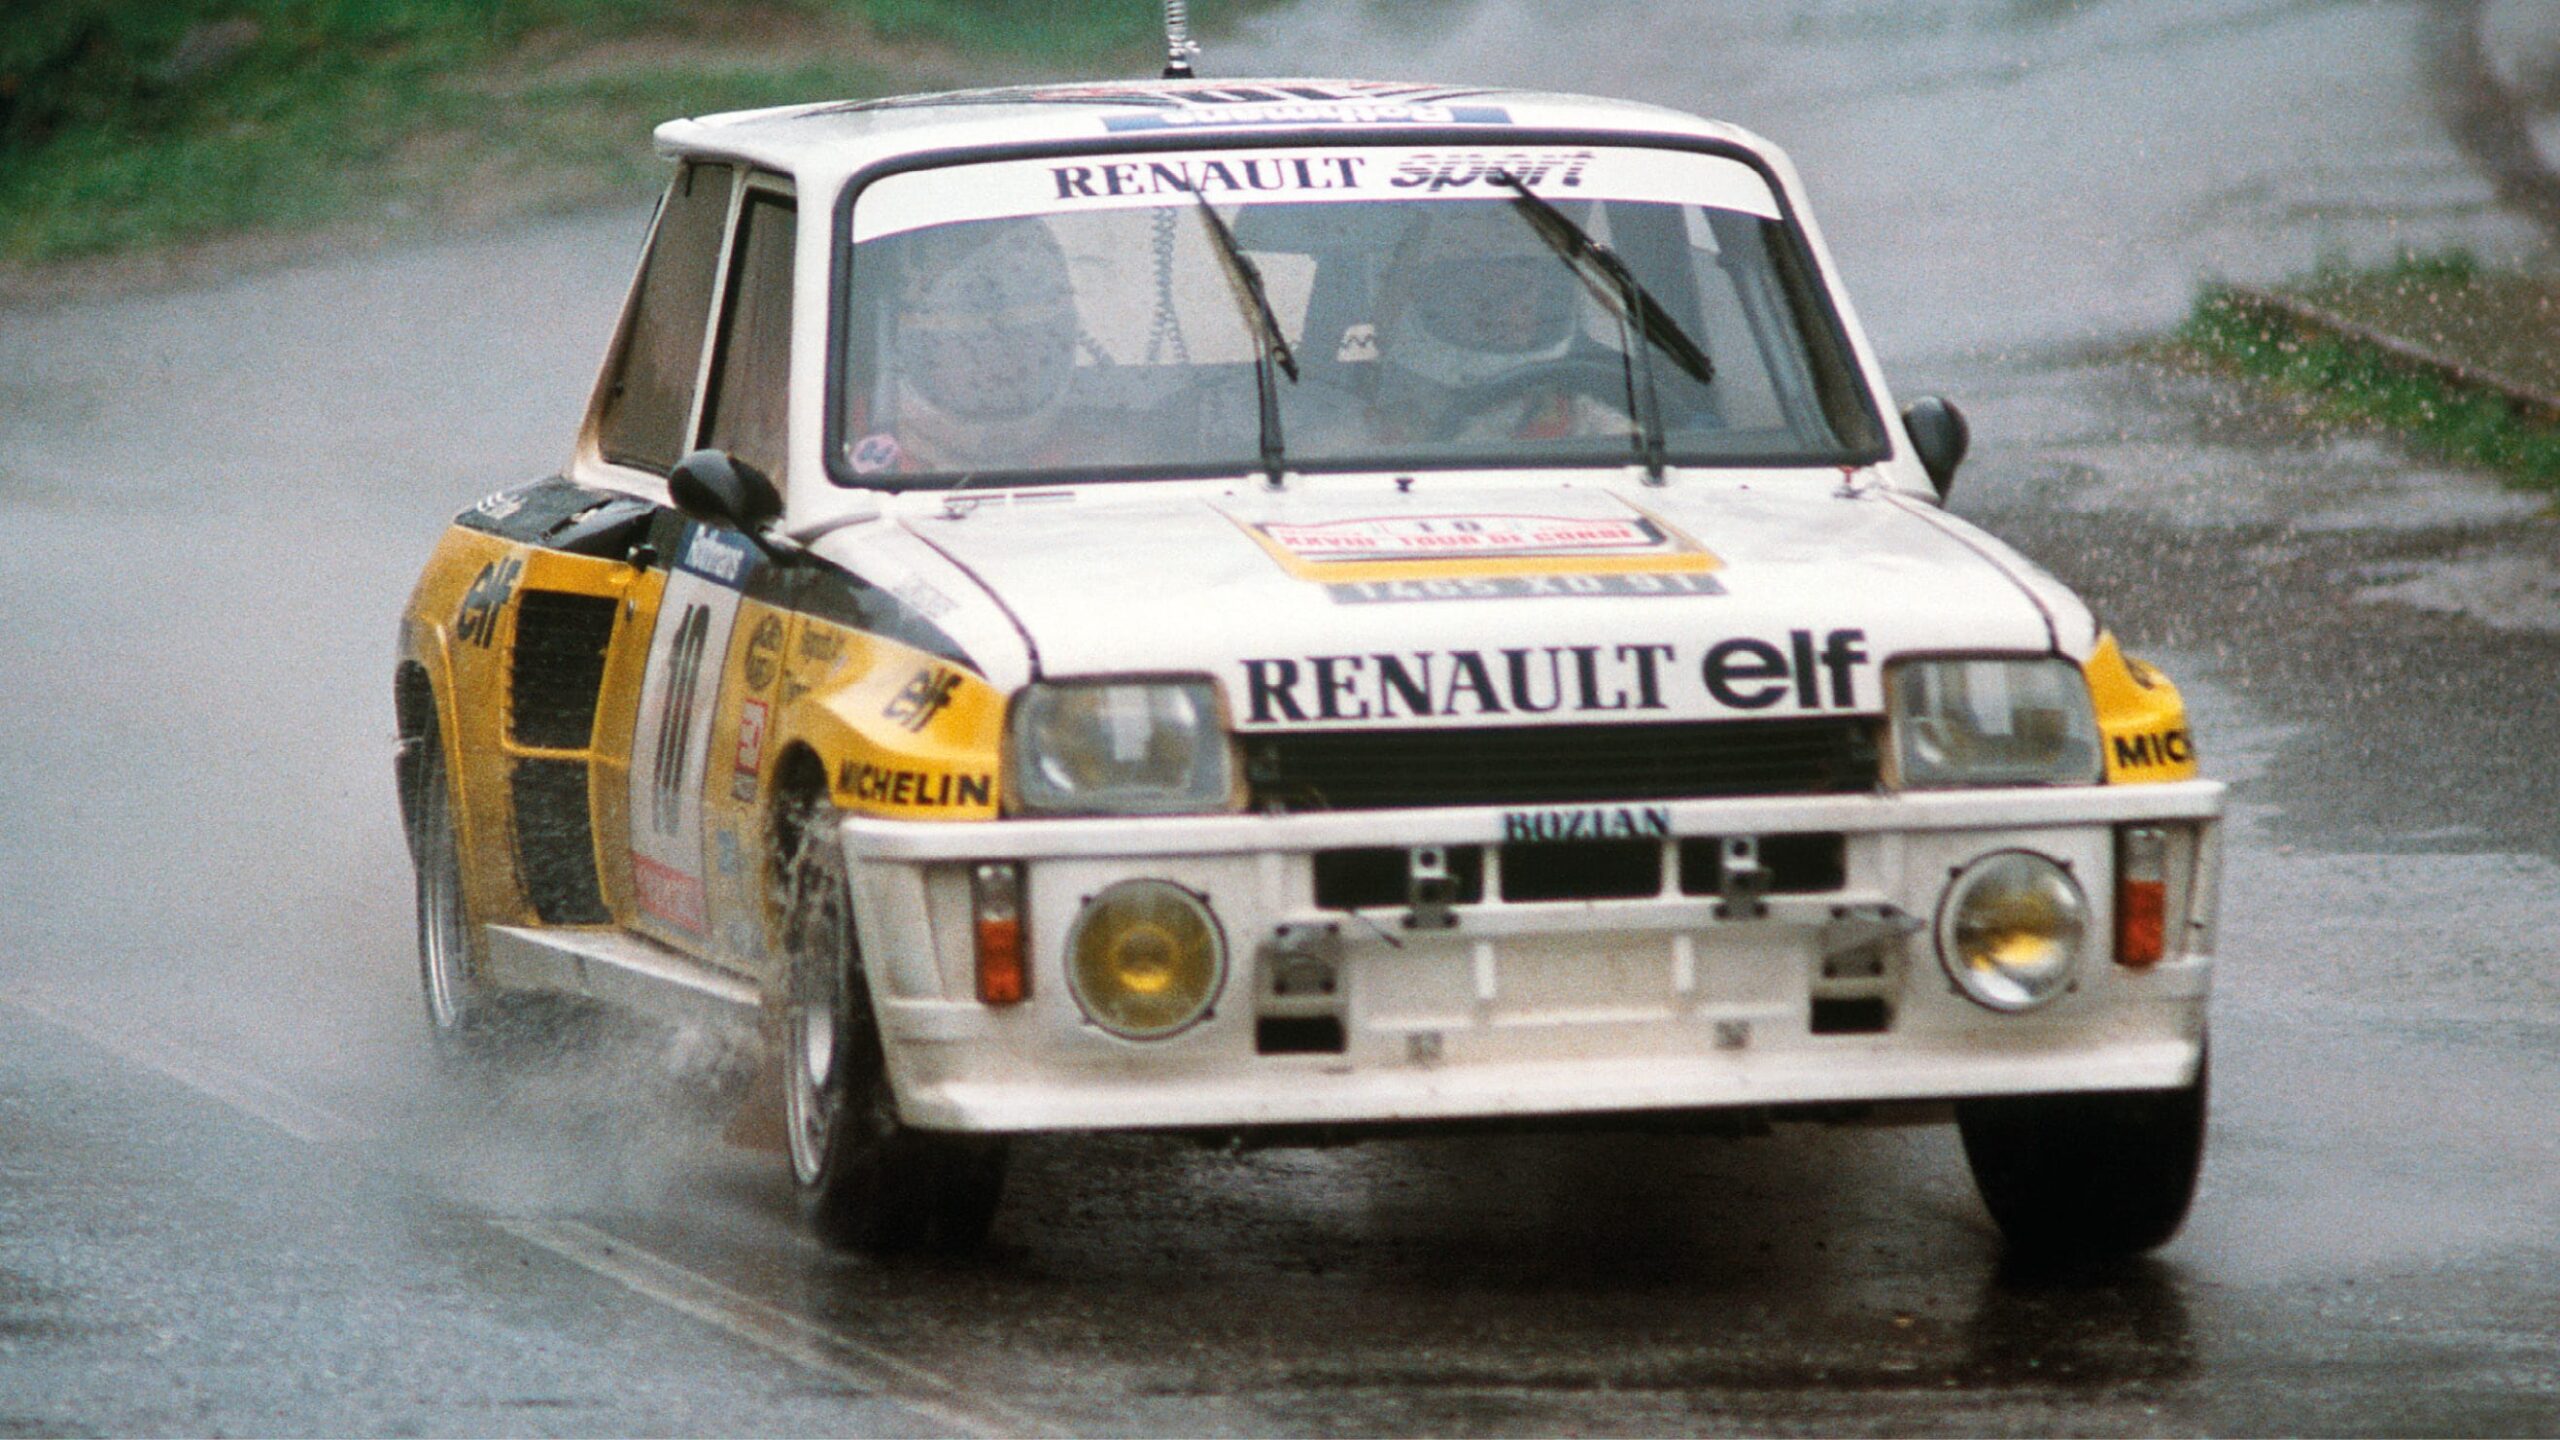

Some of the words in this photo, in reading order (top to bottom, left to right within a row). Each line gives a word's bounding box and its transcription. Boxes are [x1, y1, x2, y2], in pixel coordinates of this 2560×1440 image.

[1051, 157, 1365, 200] RENAULT
[1389, 152, 1596, 192] sport
[457, 556, 523, 650] elf
[881, 666, 963, 734] elf
[1241, 644, 1676, 723] RENAULT
[1702, 629, 1868, 710] elf
[1500, 807, 1671, 843] BOZIAN
